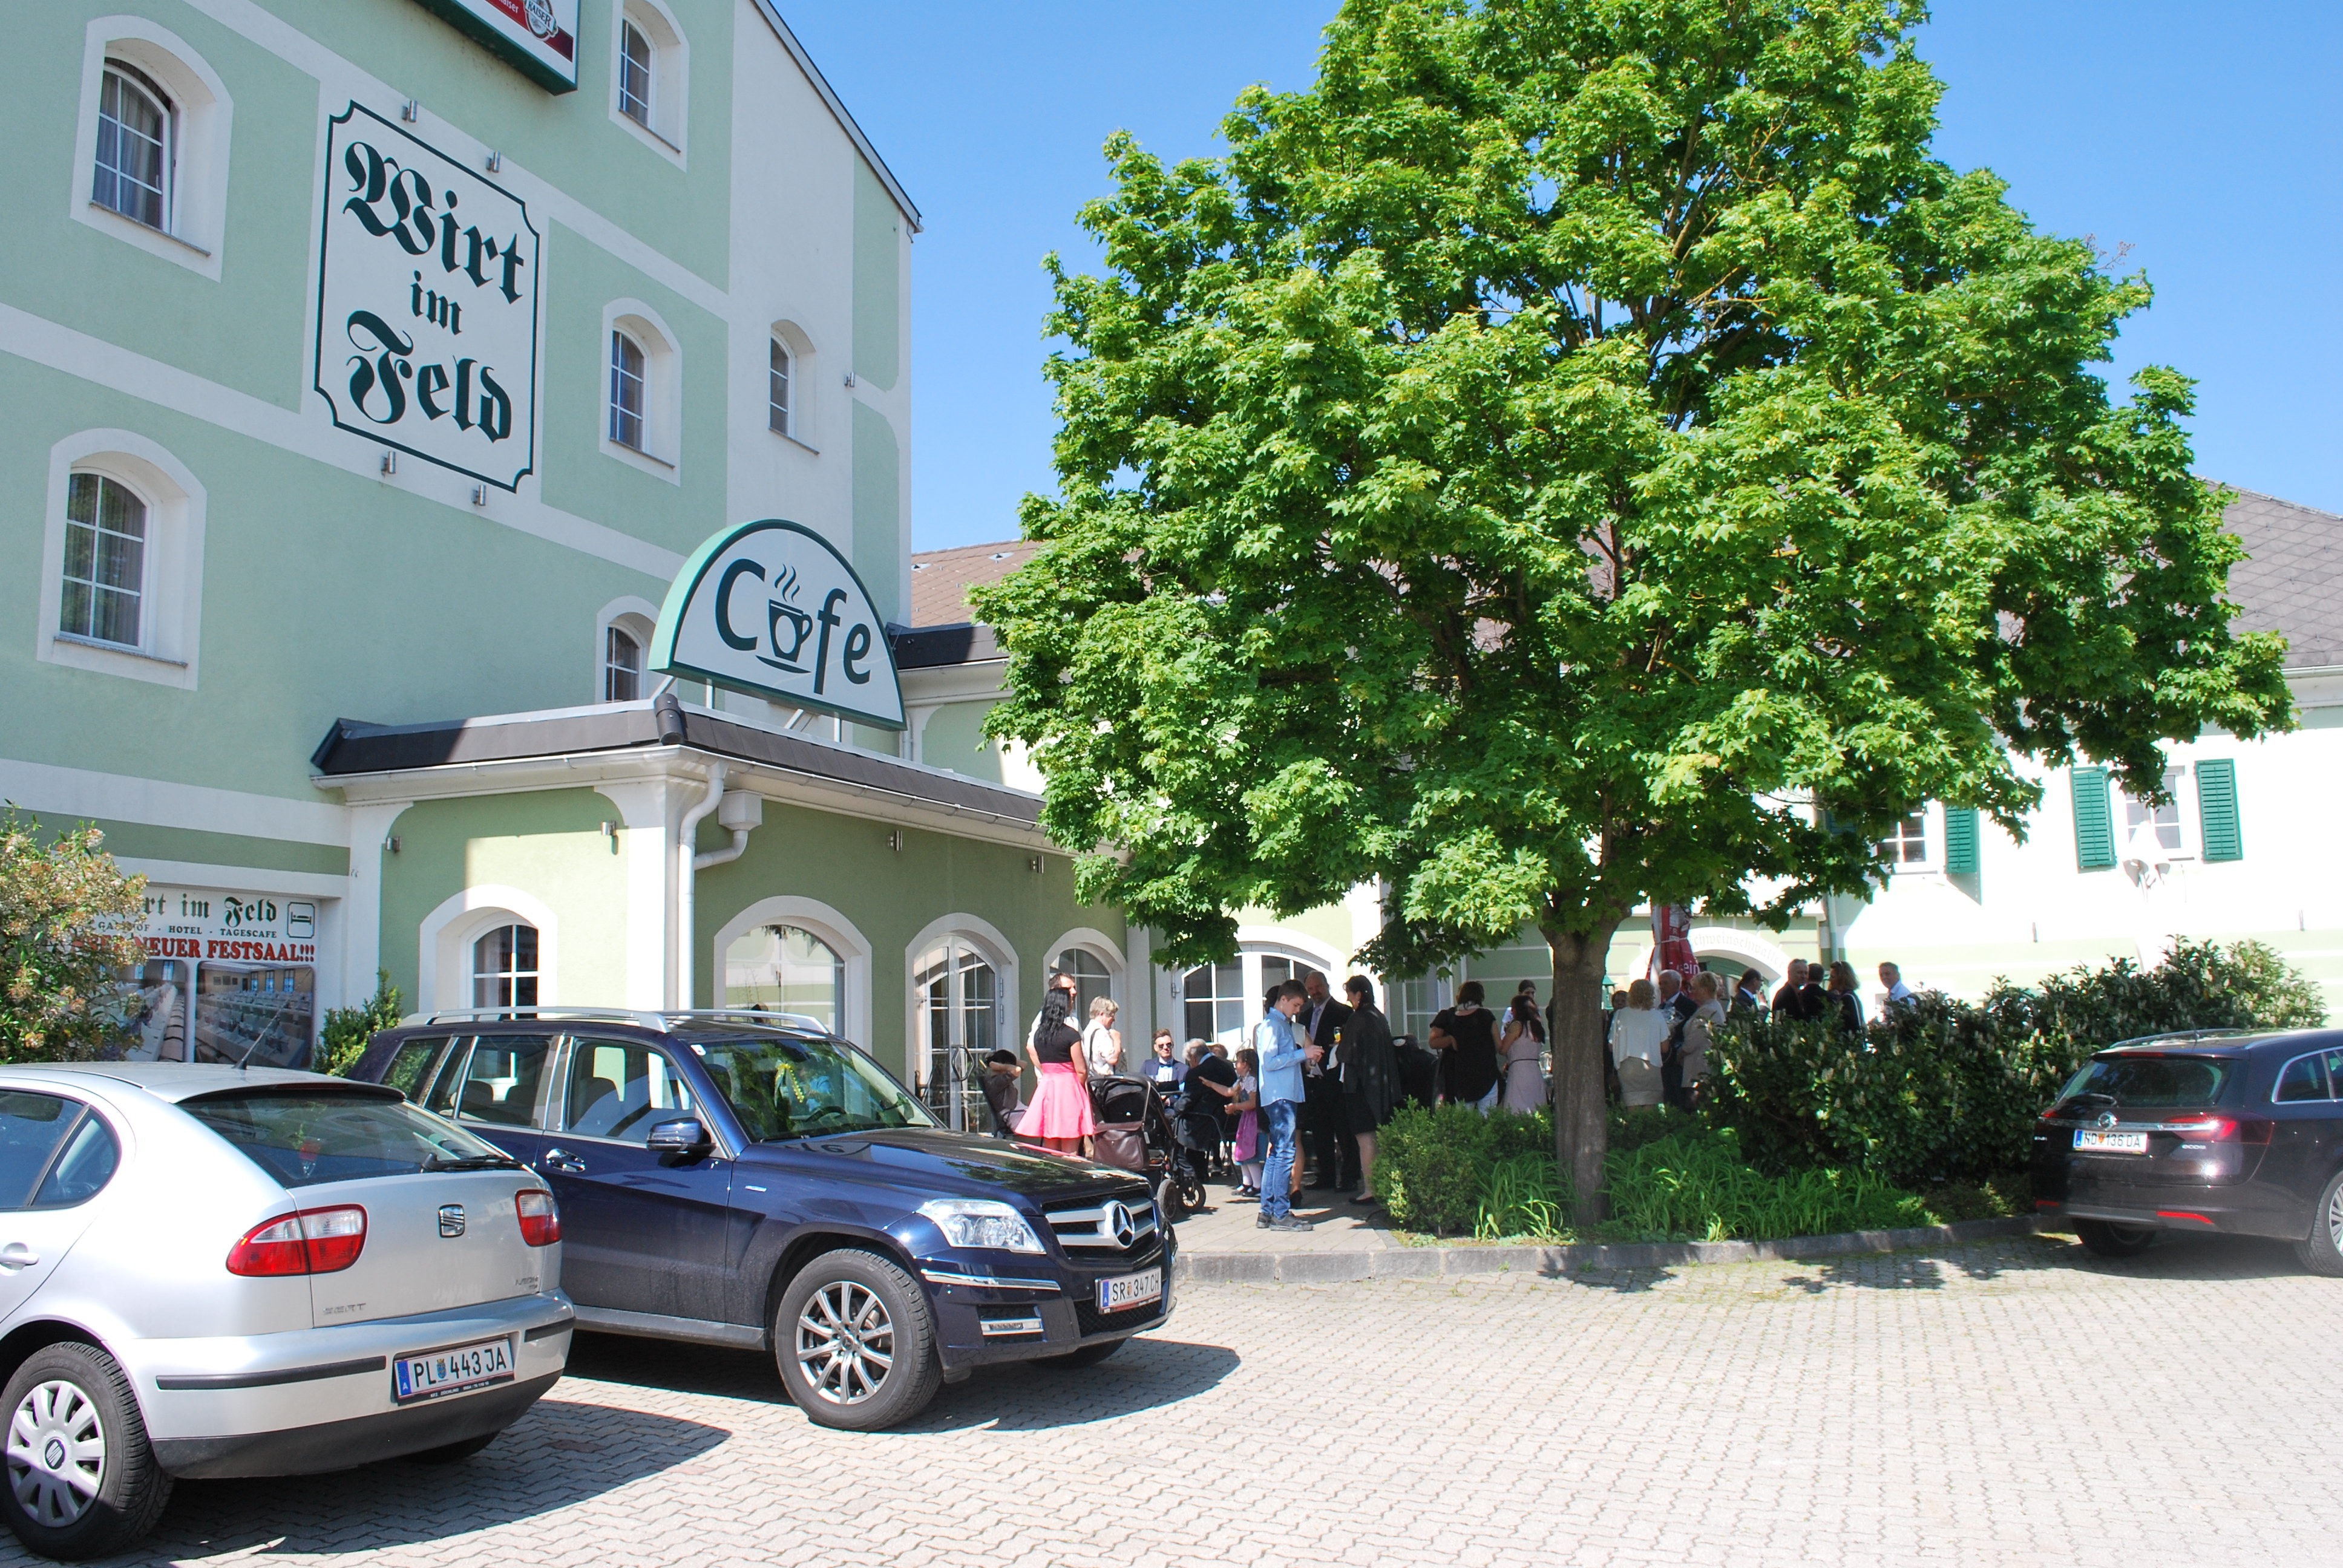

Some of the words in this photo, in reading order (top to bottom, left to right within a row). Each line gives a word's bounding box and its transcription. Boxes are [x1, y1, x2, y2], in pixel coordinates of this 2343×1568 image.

[528, 1, 551, 27] KAISER
[343, 140, 525, 304] Wirt
[410, 270, 463, 336] im
[346, 309, 513, 443] Feld
[182, 893, 210, 919] im
[224, 897, 277, 928] Feld
[169, 925, 203, 935] HOTEL
[220, 928, 277, 938] TAGESCAFE
[207, 939, 315, 962] FESTSAAL!!!
[2084, 1132, 2097, 1145] ND
[2106, 1134, 2124, 1147] 136
[2126, 1135, 2140, 1148] DA
[1112, 1282, 1126, 1301] SR
[1133, 1276, 1149, 1297] 347
[1150, 1272, 1159, 1292] CH
[323, 1302, 367, 1316] SEAT
[402, 1382, 409, 1391] A
[413, 1361, 437, 1388] PL
[450, 1351, 482, 1379] 443
[484, 1347, 507, 1373] JA
